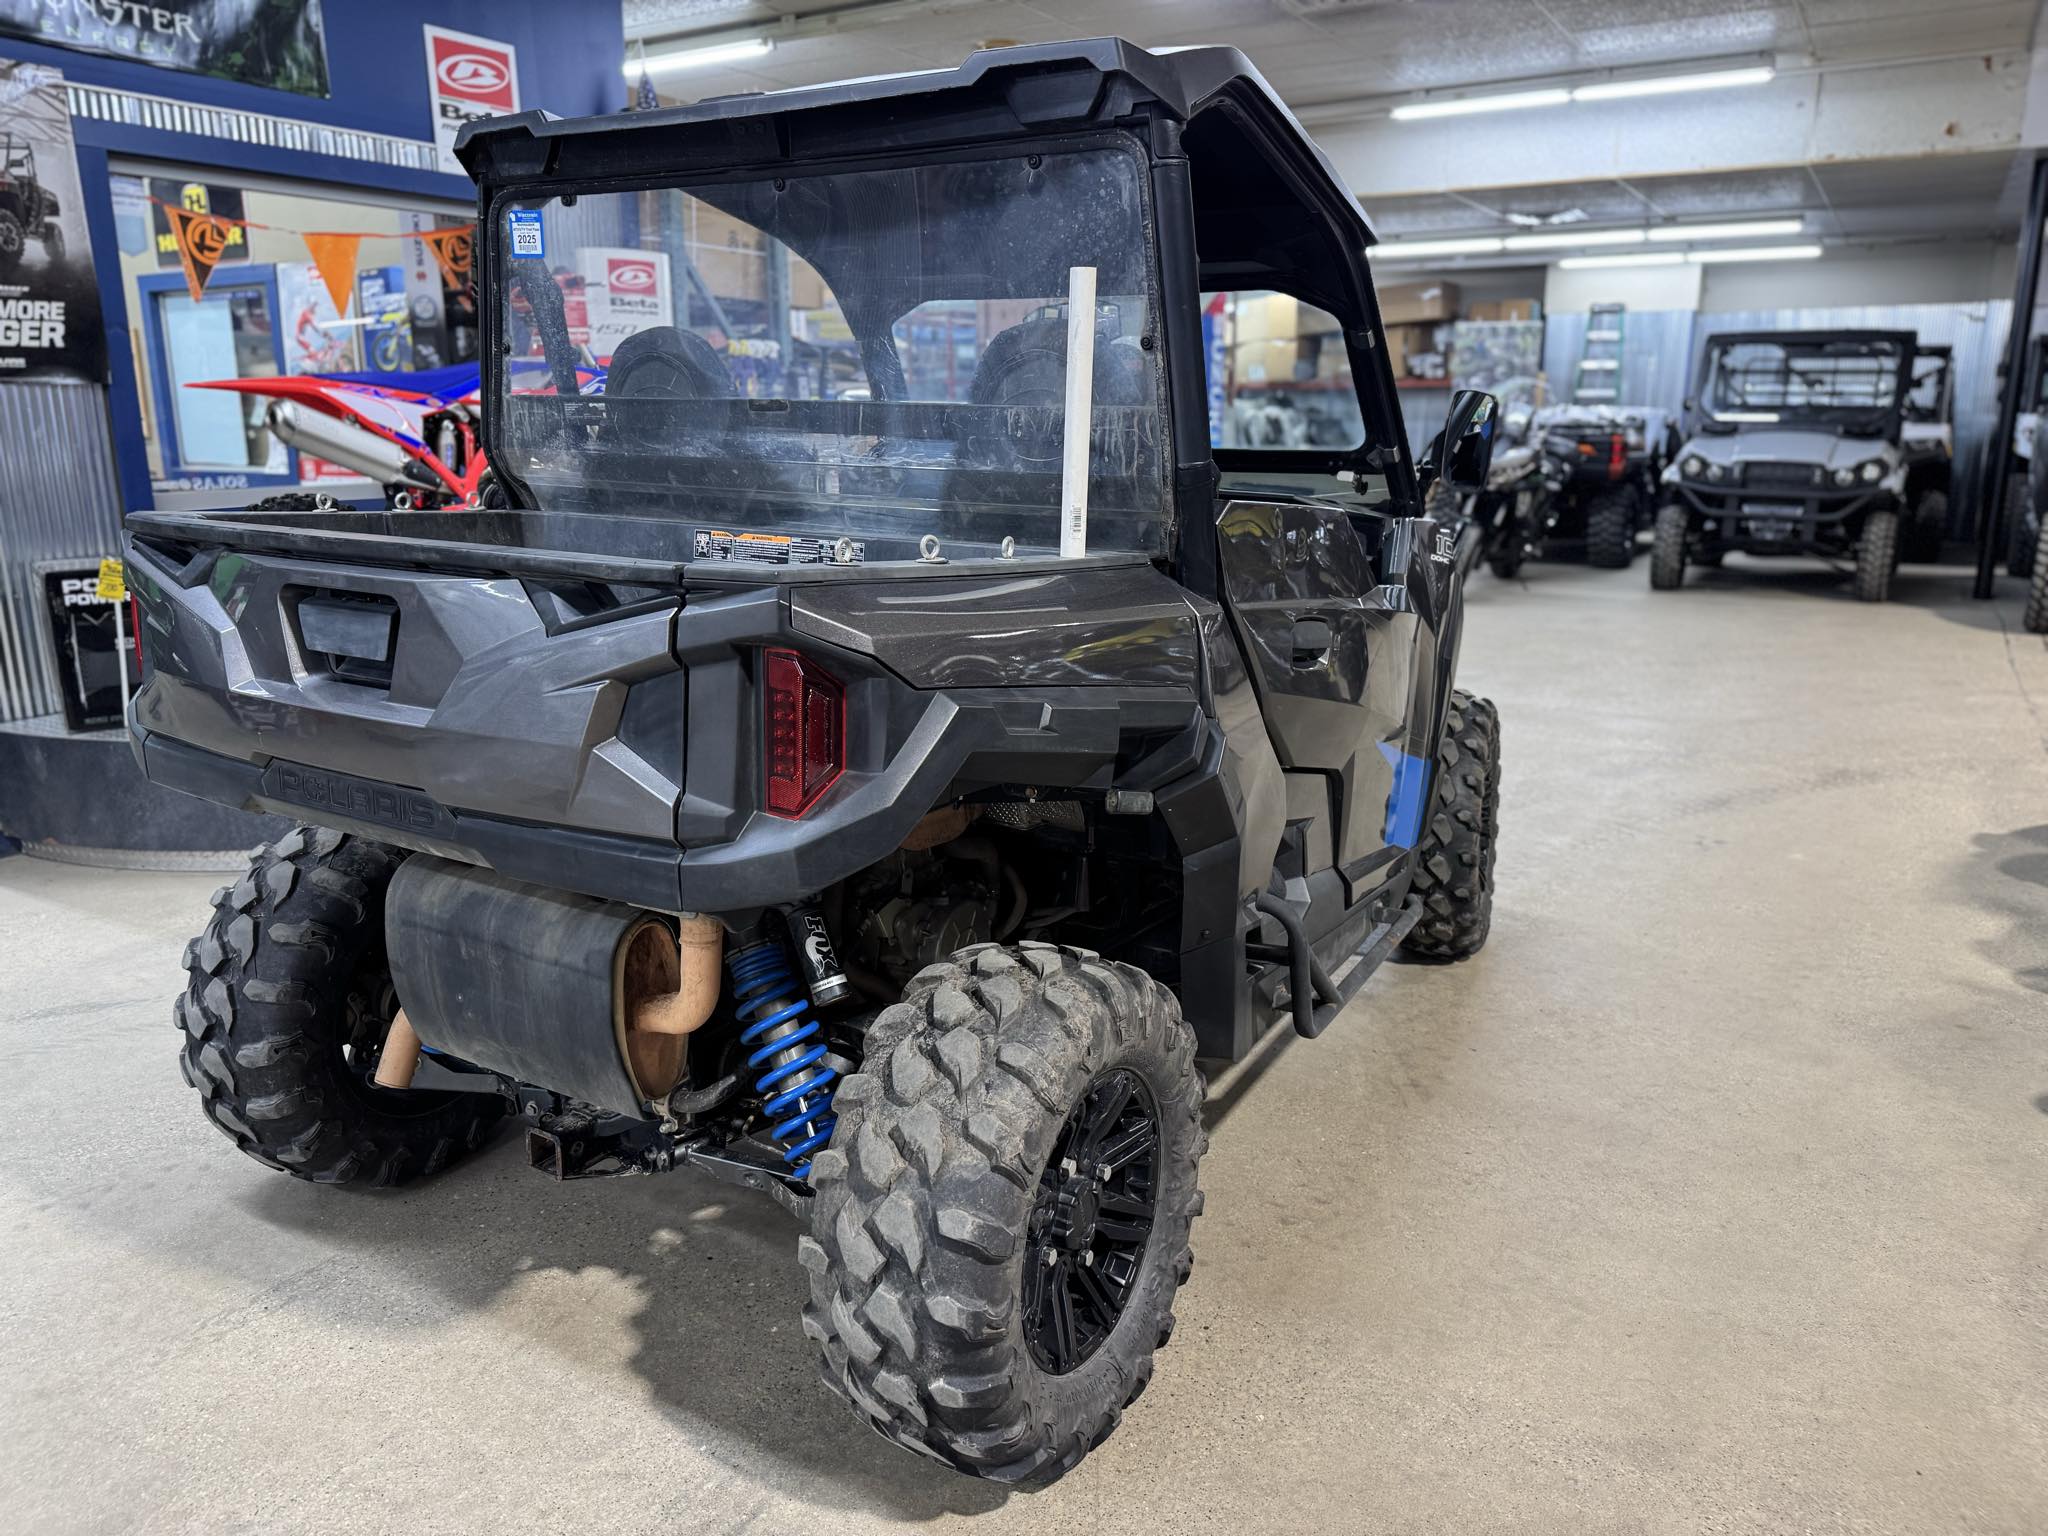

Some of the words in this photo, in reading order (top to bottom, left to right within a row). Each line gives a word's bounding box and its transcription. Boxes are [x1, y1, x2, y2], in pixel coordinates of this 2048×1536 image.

[32, 0, 201, 43] NSTER
[40, 19, 178, 57] ENERGY
[440, 103, 493, 122] Be
[517, 234, 537, 244] 2025
[0, 299, 66, 321] MORE
[610, 297, 659, 309] Beta
[279, 766, 434, 827] POLARIS
[804, 916, 839, 974] FOX
